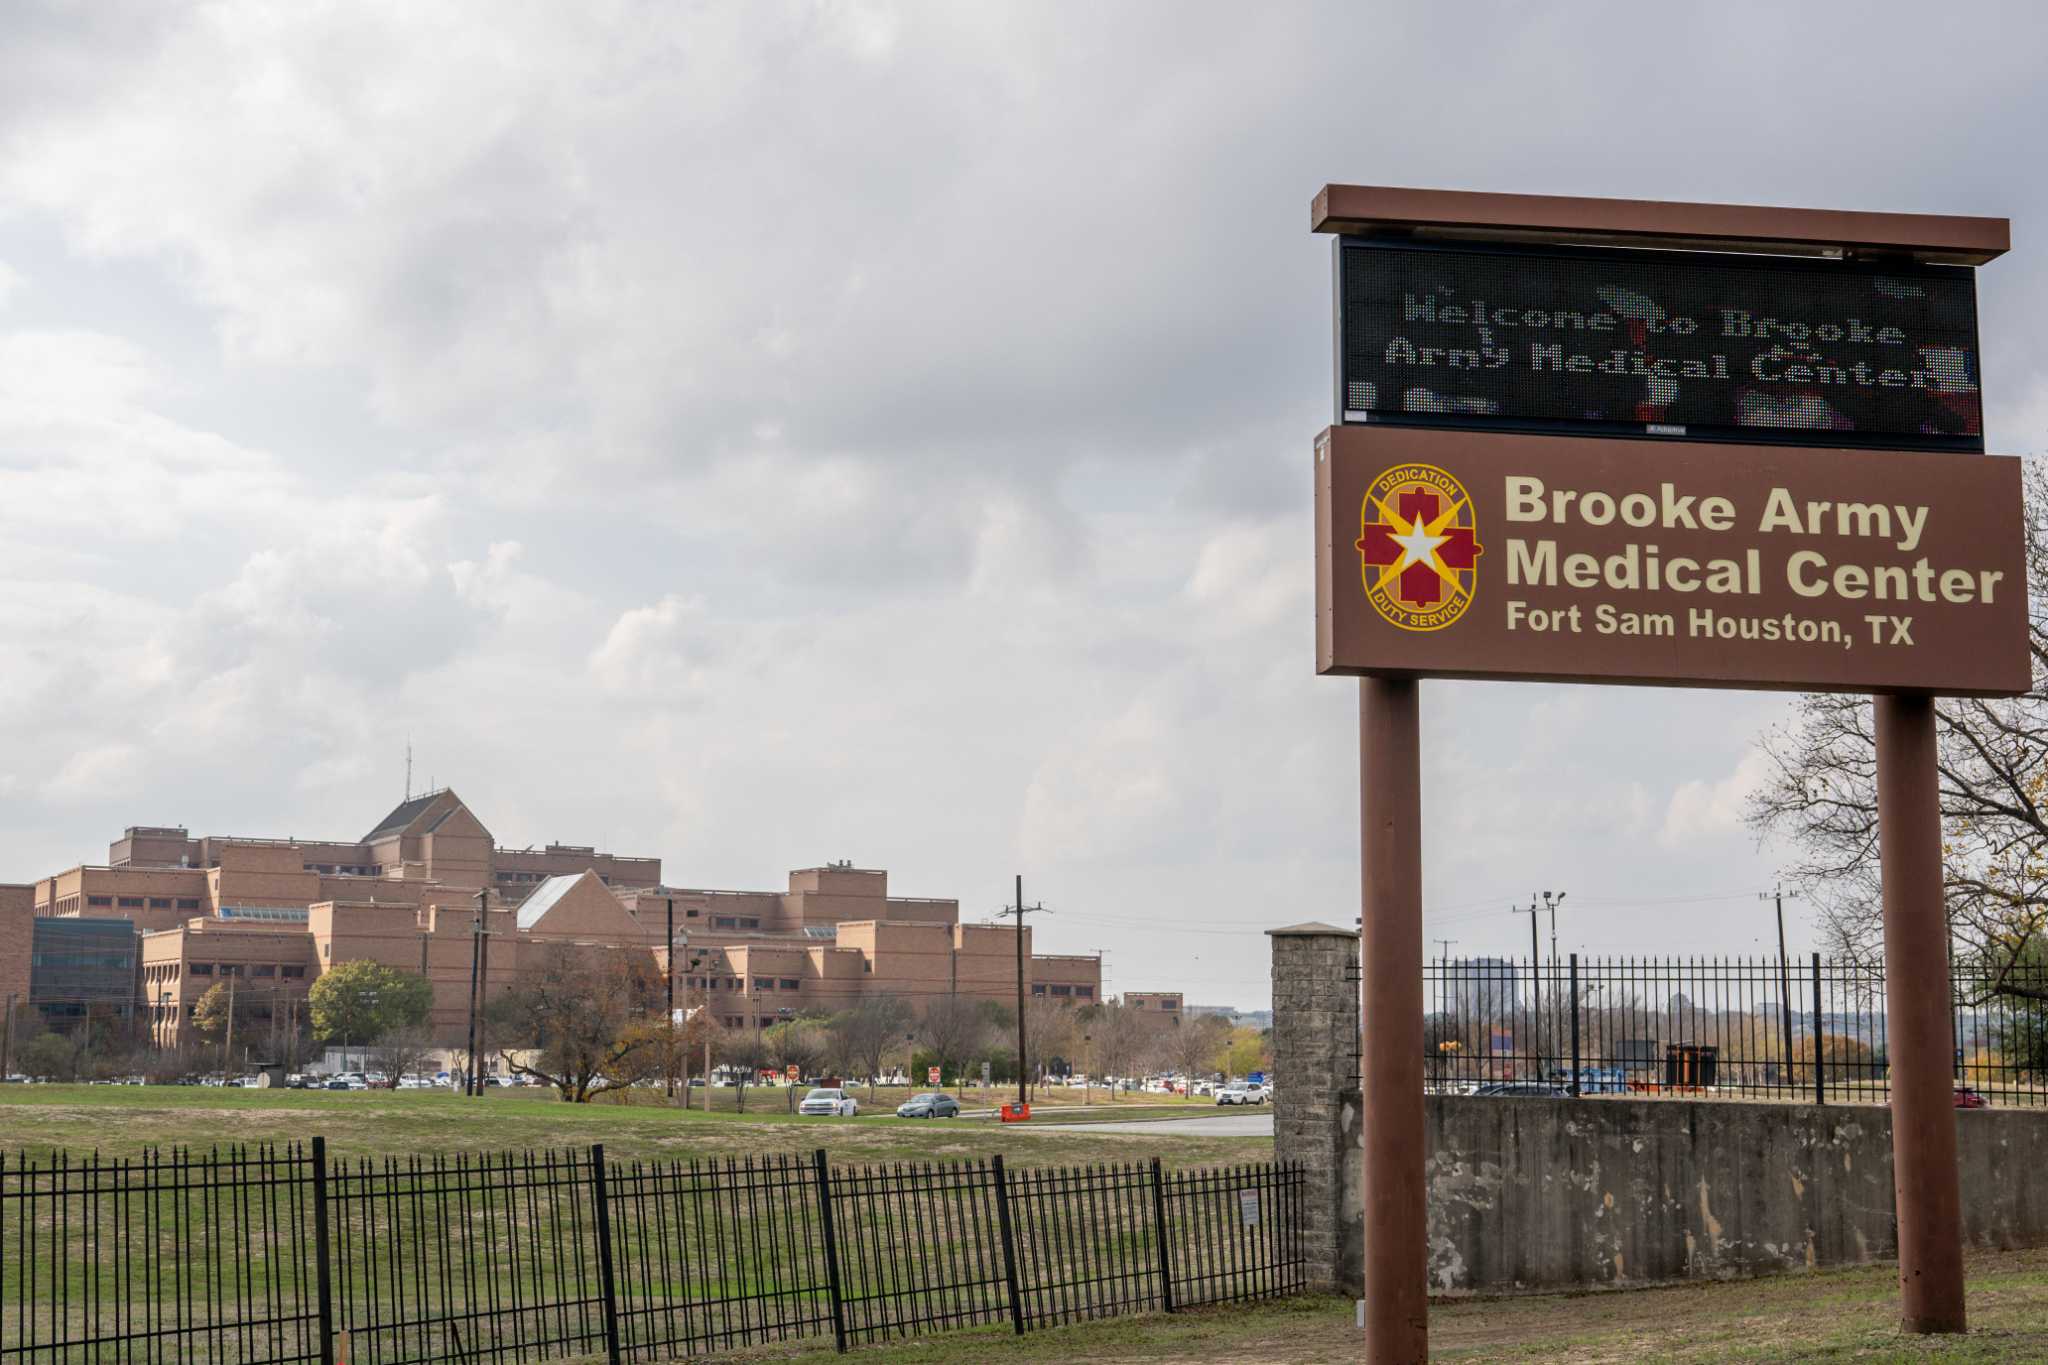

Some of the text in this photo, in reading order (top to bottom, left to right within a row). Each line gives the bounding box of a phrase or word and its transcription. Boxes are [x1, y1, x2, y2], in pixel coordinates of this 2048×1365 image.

[1404, 293, 1906, 345] Welcome to Brooke
[1531, 343, 1730, 379] Medical
[1751, 349, 1931, 388] Center
[1378, 469, 1458, 497] DEDICATION
[1505, 475, 1929, 551] Brooke Army
[1506, 538, 2004, 604] Medical Center
[1374, 589, 1465, 627] DUTY SERVICE
[1507, 600, 1914, 650] Fort Sam Houston, TX
